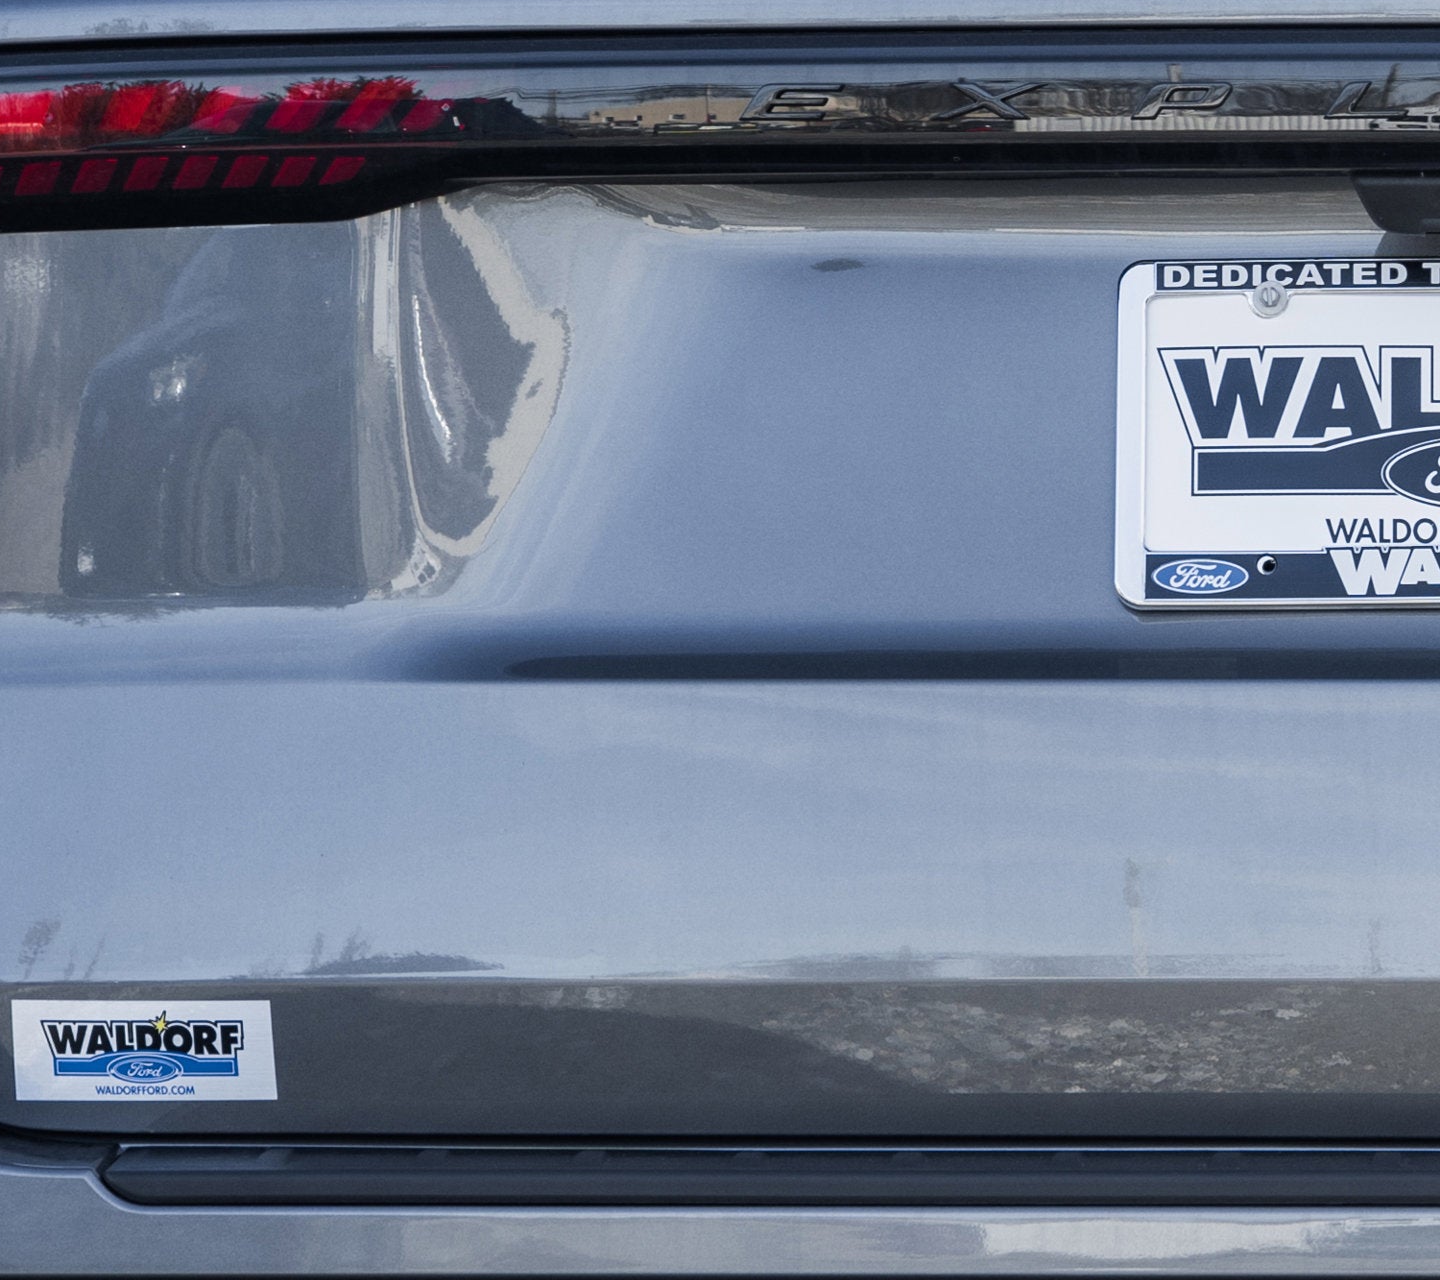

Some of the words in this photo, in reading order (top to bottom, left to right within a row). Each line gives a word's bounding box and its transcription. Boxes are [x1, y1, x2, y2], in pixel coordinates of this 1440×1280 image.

[1162, 262, 1408, 288] DEDICATED
[1169, 563, 1231, 589] Ford
[47, 1023, 240, 1056] WALDORF
[127, 1061, 163, 1077] Ford
[95, 1084, 196, 1096] WALDORFFORD.COM
